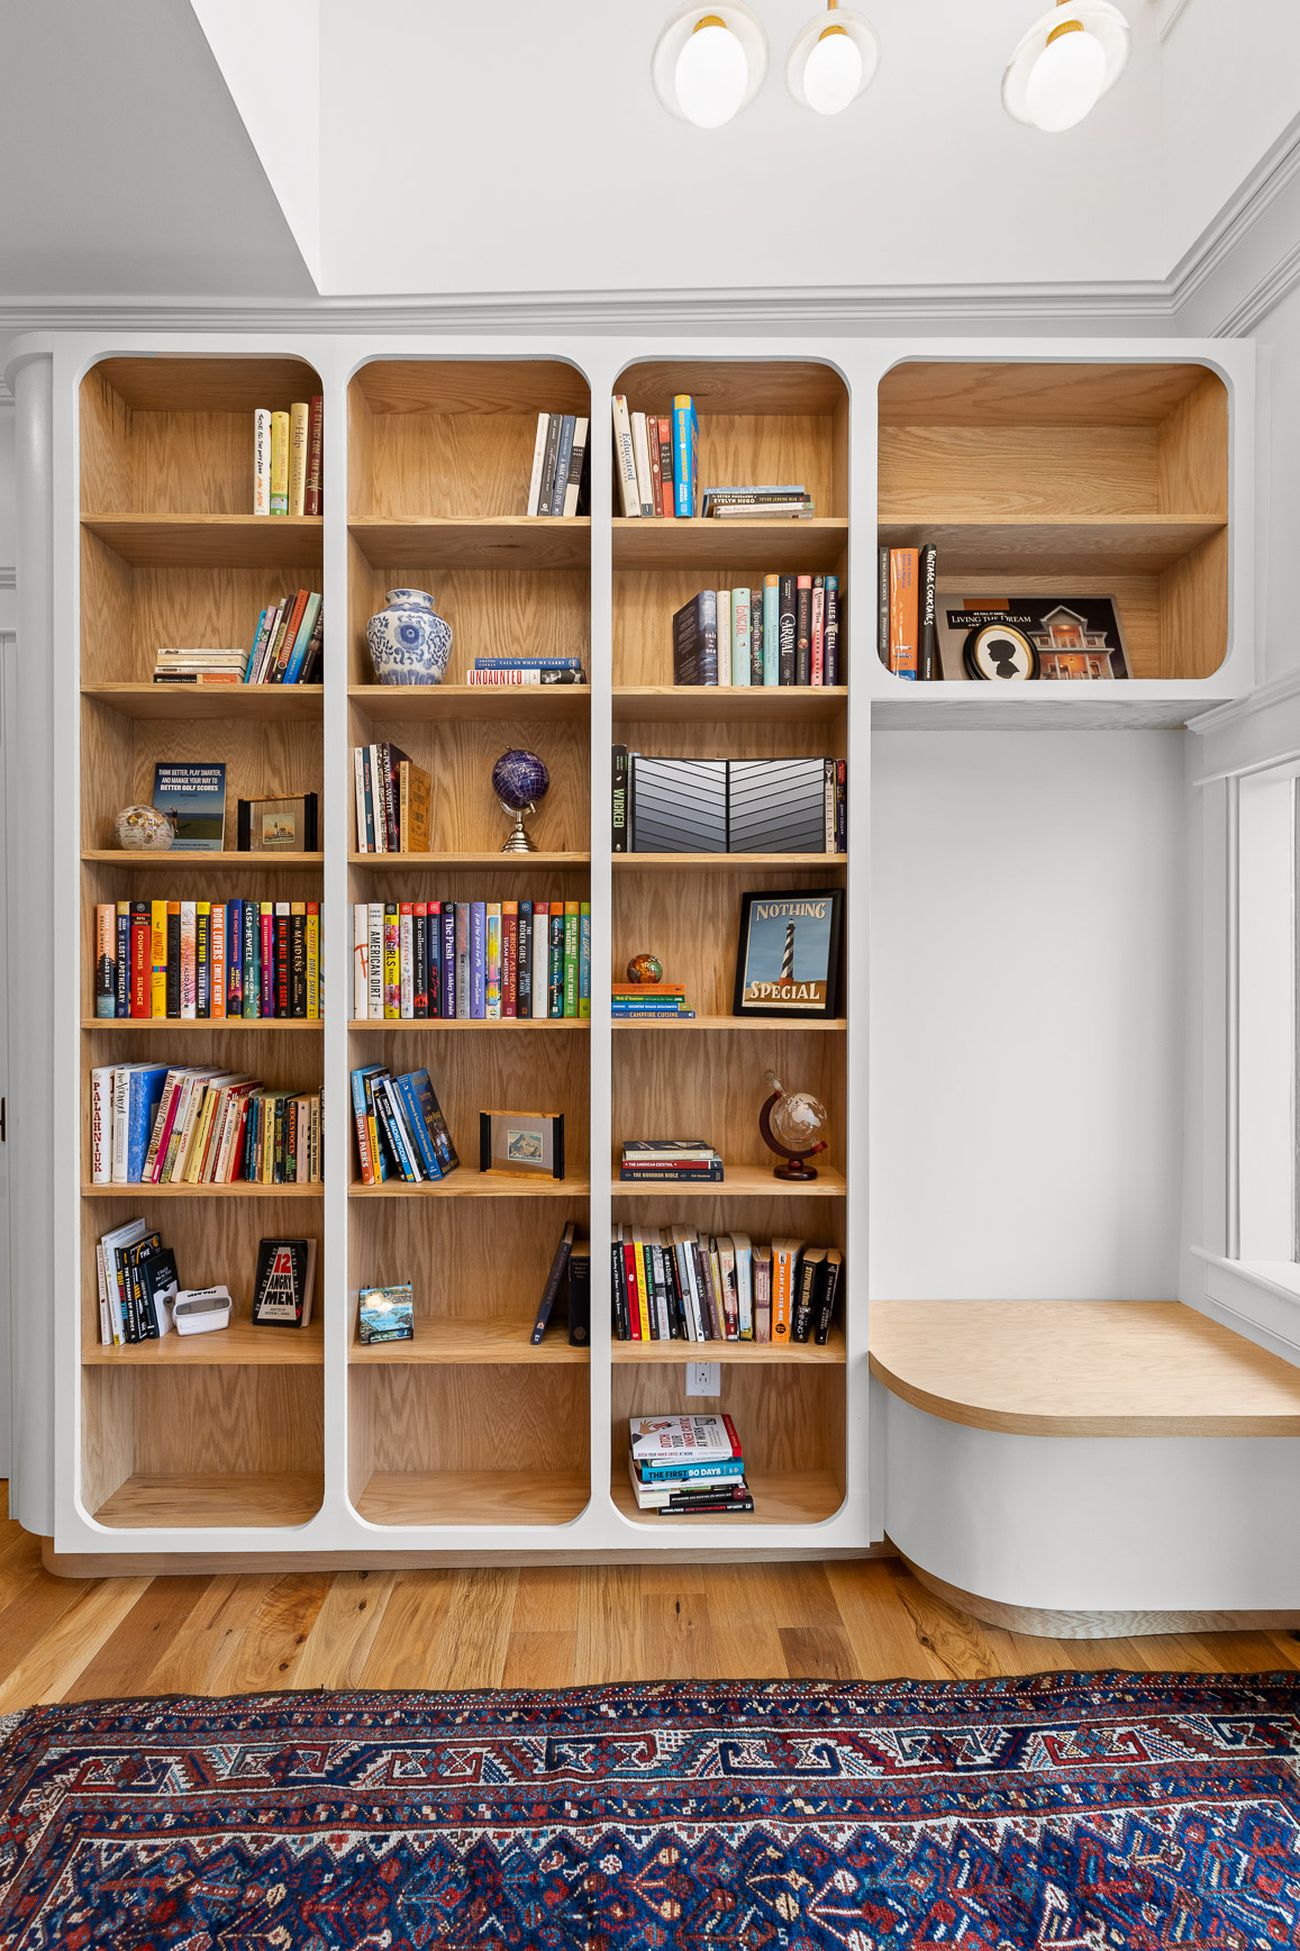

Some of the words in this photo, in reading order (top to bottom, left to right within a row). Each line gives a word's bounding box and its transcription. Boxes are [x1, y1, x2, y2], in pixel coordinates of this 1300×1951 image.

[294, 426, 304, 448] Help
[622, 433, 635, 481] Educated
[927, 550, 936, 582] VINTAGE
[924, 584, 935, 625] COCKTAILS
[753, 612, 761, 640] foolish
[780, 613, 796, 656] CARAVAL
[470, 670, 522, 685] UNDAUNTED
[385, 789, 393, 814] WRITE
[613, 789, 624, 828] WICKED
[213, 908, 223, 928] BOOK
[757, 903, 826, 921] NOTHING
[279, 920, 287, 938] FINAL
[445, 917, 454, 935] The
[510, 921, 516, 931] AS
[213, 931, 223, 960] LOVERS
[279, 940, 287, 959] GIRLS
[294, 930, 302, 972] MAIDENS
[370, 931, 380, 975] AMERICAN
[387, 941, 396, 966] GIRLS
[445, 937, 454, 960] Push
[213, 964, 223, 983] EMILY
[279, 964, 287, 982] RILEY
[510, 960, 516, 971] AS
[198, 966, 206, 987] TAYLOR
[198, 989, 206, 1008] ADAMS
[214, 985, 223, 1005] HENRY
[279, 985, 287, 1007] SAGER
[371, 979, 380, 998] DIRT
[750, 981, 820, 999] SPECIAL
[94, 1082, 102, 1172] PALAHNIUK
[356, 1109, 366, 1140] SUBPAR
[388, 1119, 401, 1141] MACHU
[396, 1142, 408, 1163] PICCHU
[359, 1141, 368, 1167] PARKS
[274, 1254, 291, 1273] 12
[268, 1274, 292, 1289] ANGRY
[803, 1267, 813, 1290] STEPHEN
[264, 1292, 293, 1305] MEN
[801, 1291, 810, 1306] KING
[120, 1302, 128, 1320] THIS
[665, 1470, 687, 1478] FIRST
